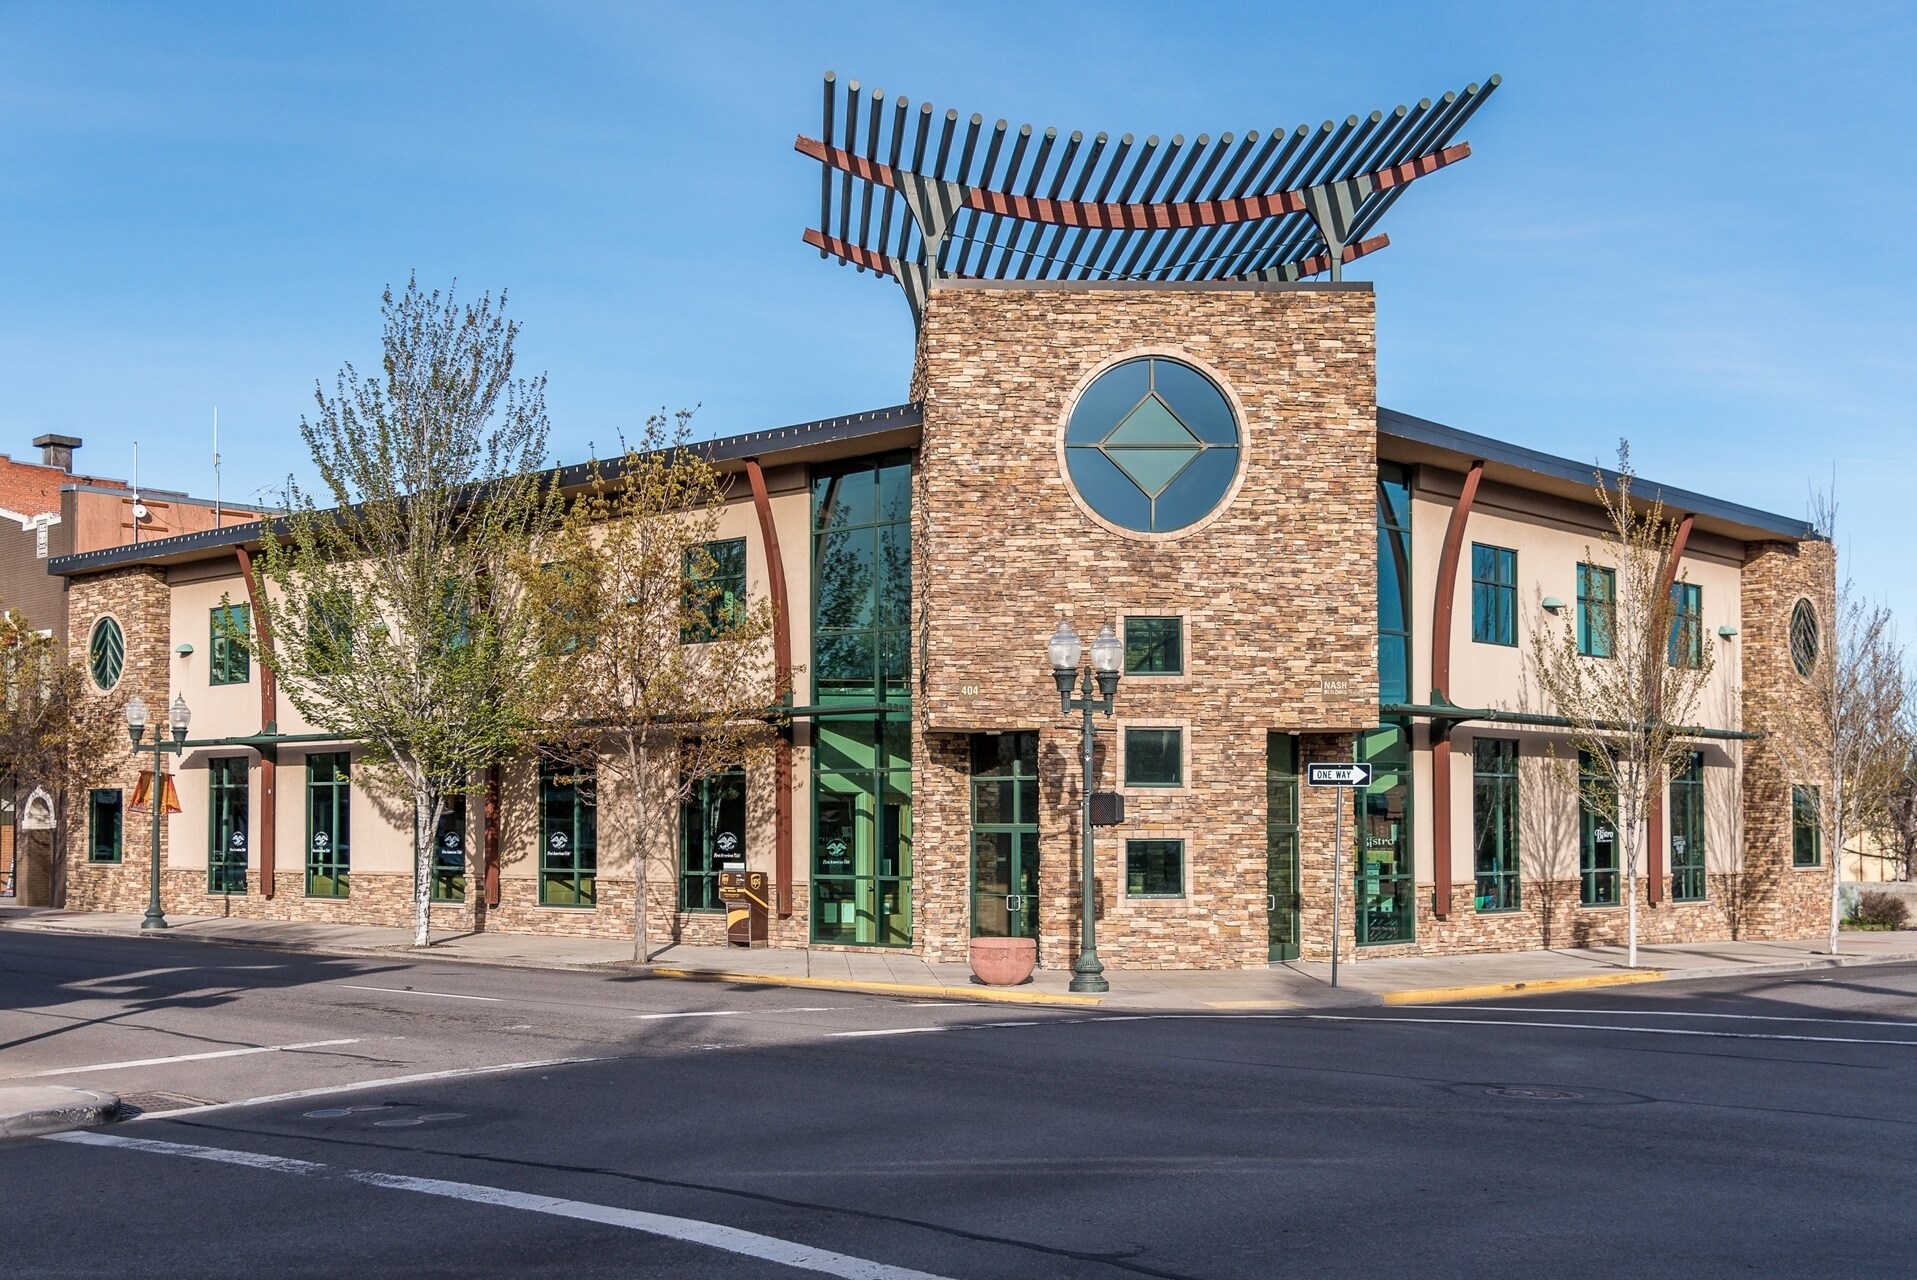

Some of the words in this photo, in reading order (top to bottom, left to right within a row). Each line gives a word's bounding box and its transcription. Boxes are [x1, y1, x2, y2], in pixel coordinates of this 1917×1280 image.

[1324, 681, 1347, 689] NASH
[961, 685, 979, 695] 404
[1317, 770, 1332, 779] ONE
[1335, 770, 1352, 779] WAY
